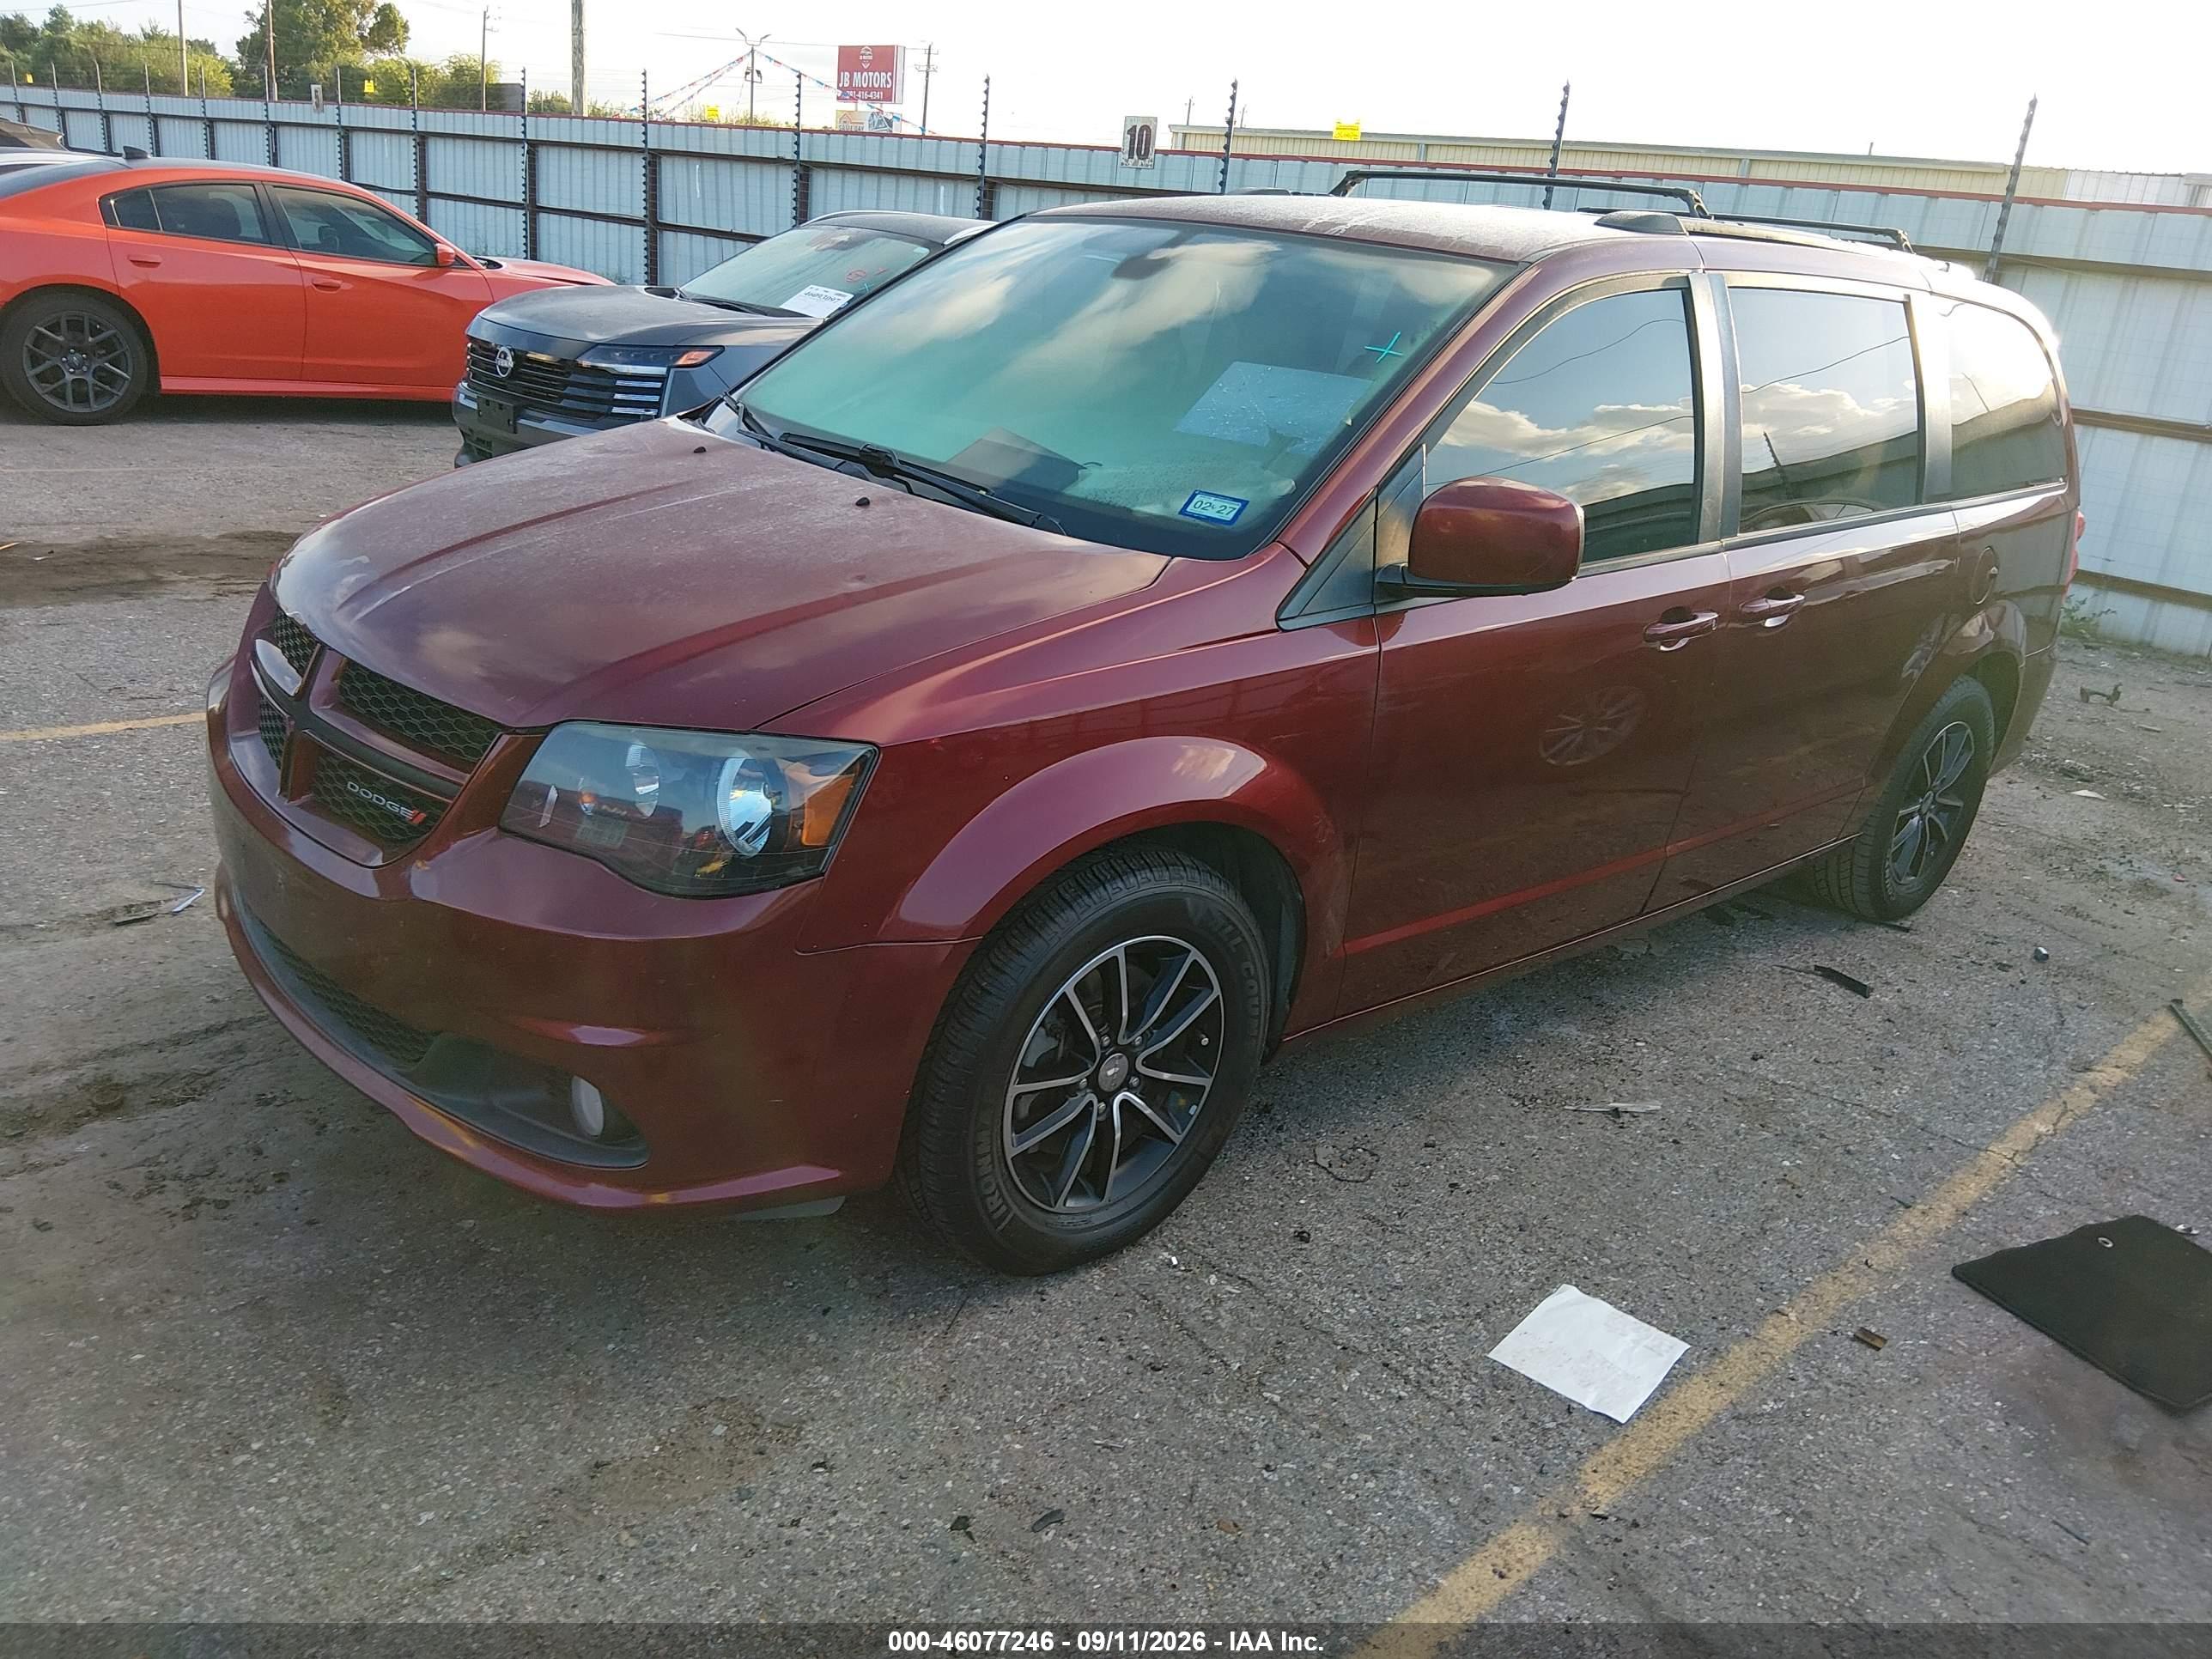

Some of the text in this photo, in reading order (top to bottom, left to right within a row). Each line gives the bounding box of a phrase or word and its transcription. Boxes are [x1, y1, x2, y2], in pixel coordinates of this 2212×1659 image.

[839, 71, 892, 88] JB MOTORS
[1127, 124, 1152, 161] 10
[347, 781, 414, 821] DODGE
